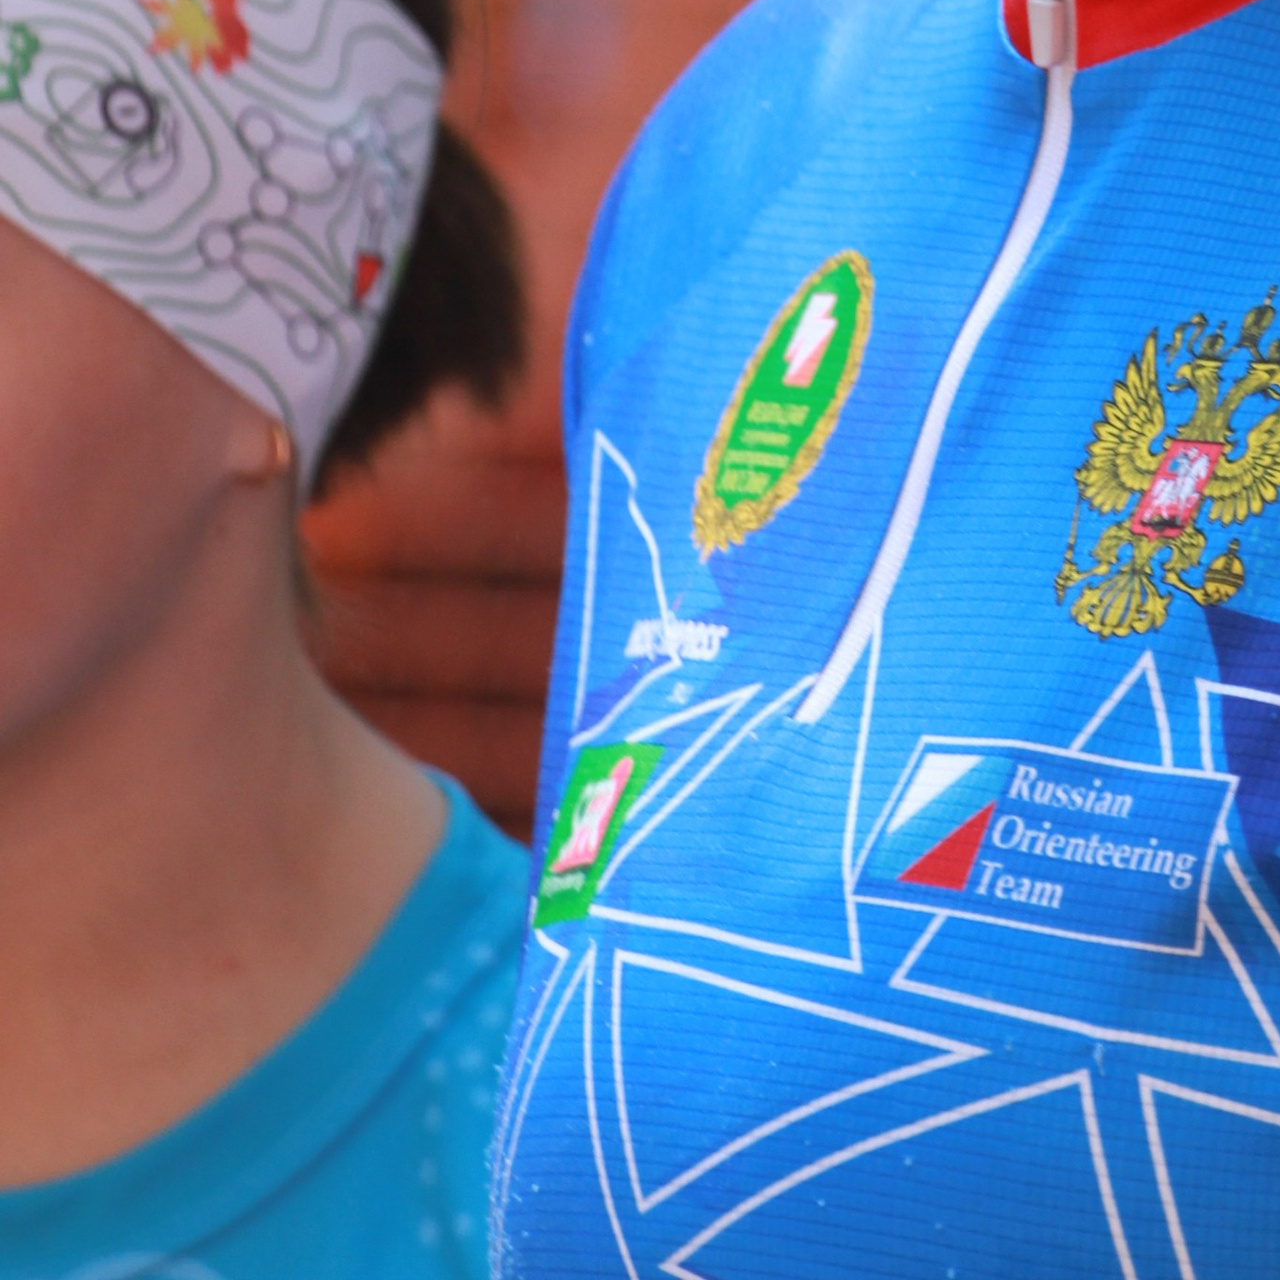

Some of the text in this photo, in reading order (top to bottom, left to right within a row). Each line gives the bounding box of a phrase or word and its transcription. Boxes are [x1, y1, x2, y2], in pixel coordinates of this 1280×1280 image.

[1006, 763, 1134, 820] Russian
[990, 814, 1197, 891] Orienteering
[973, 860, 1064, 910] Team
